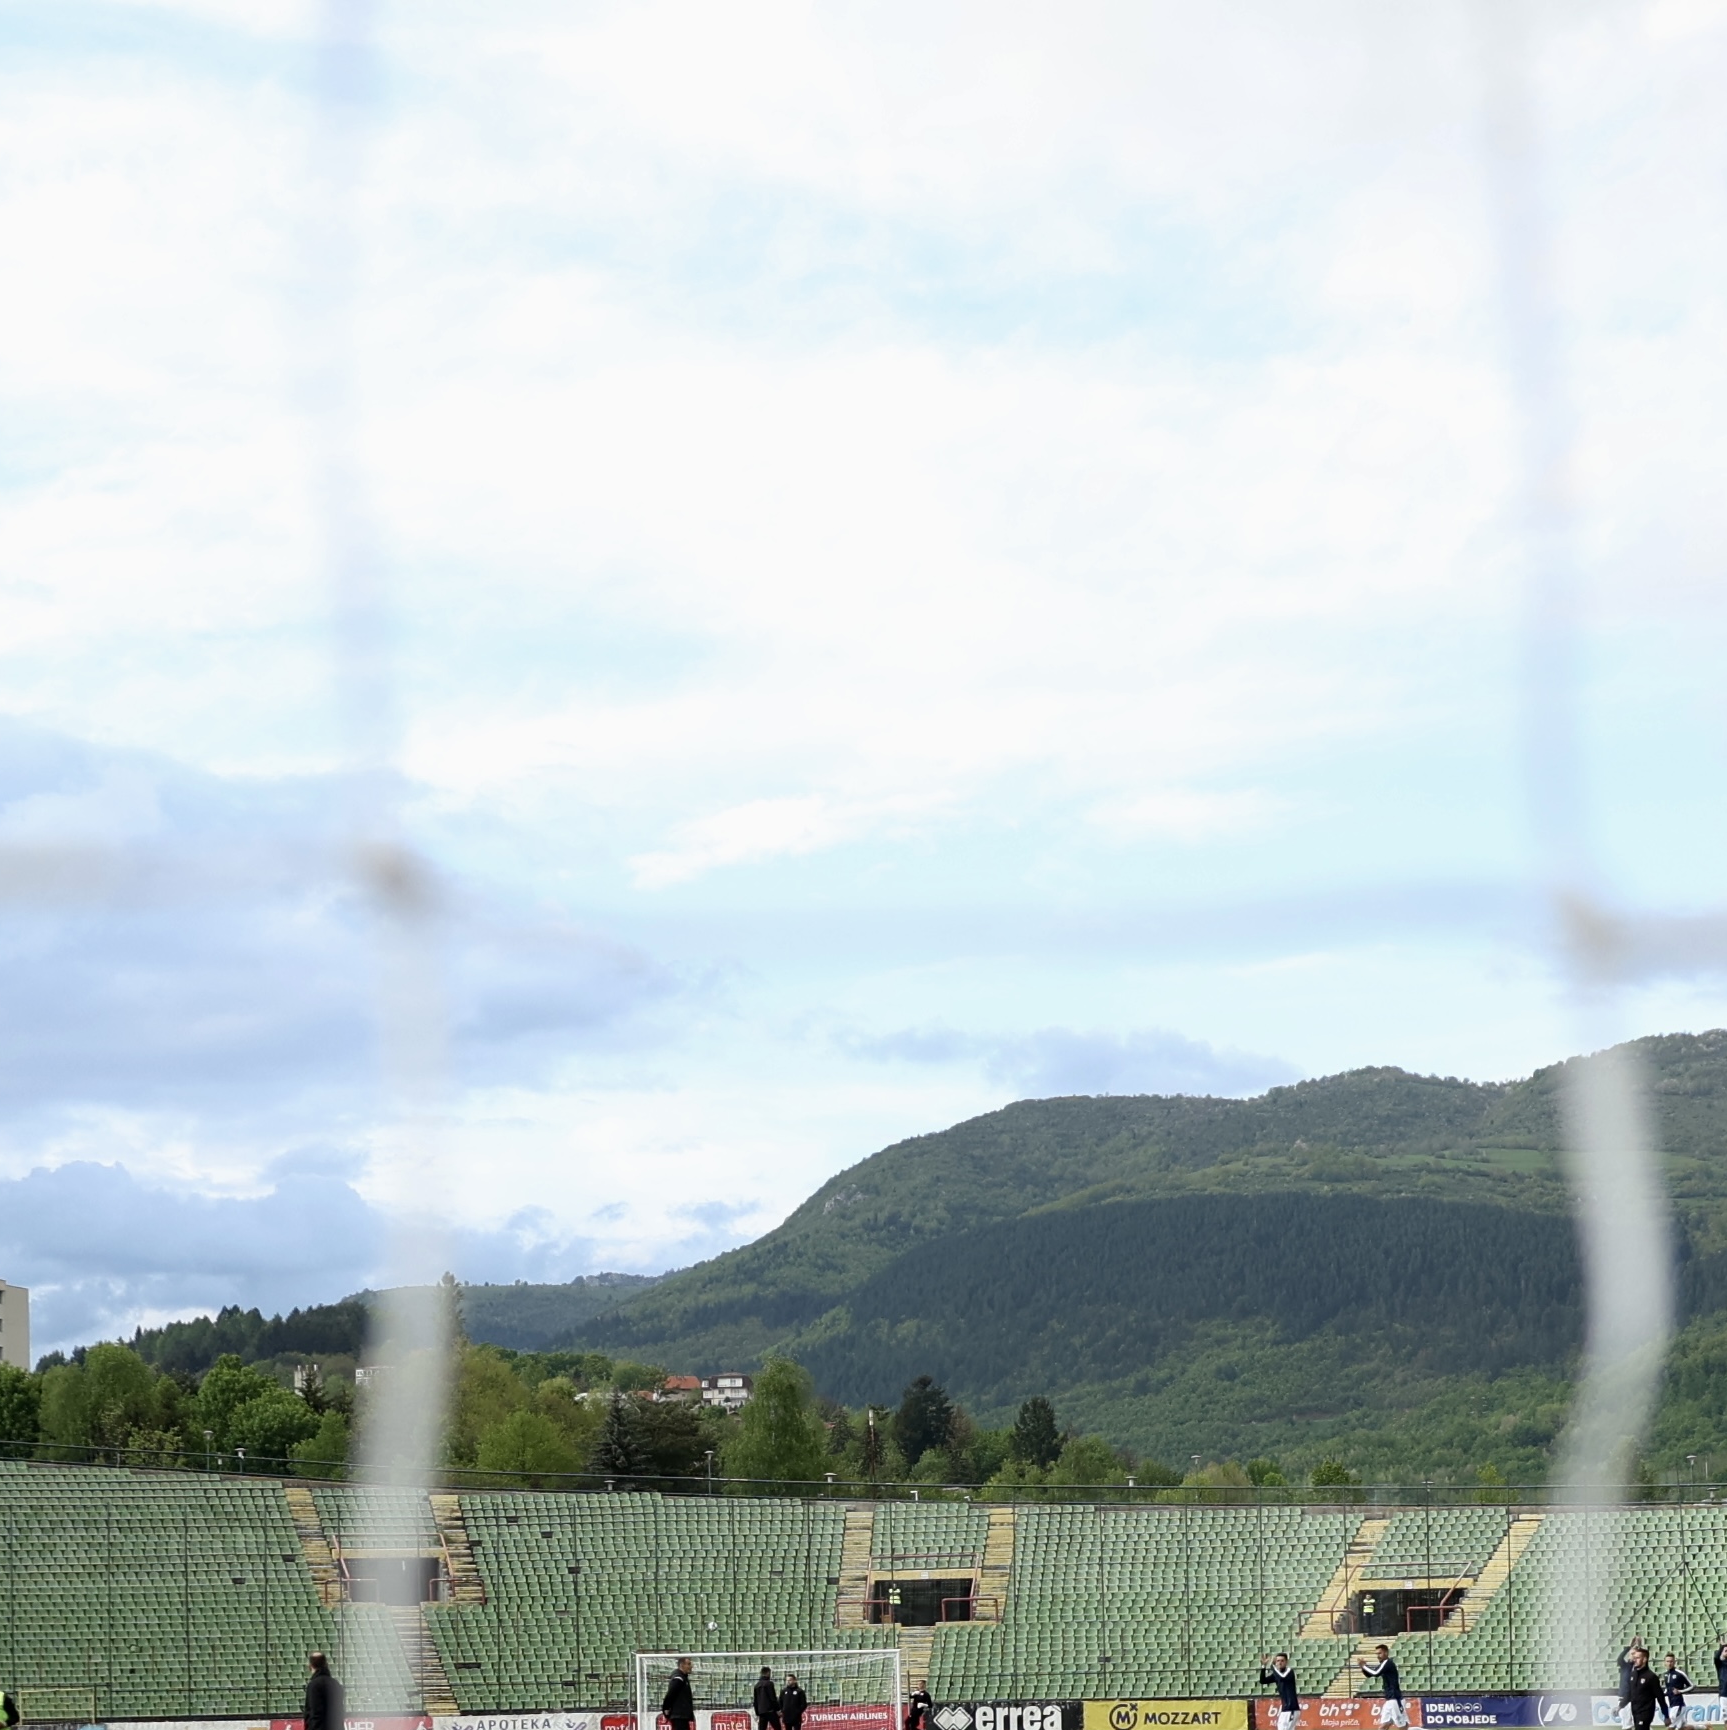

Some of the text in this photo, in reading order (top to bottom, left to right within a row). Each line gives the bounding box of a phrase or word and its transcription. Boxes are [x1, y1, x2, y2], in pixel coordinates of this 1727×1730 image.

[1425, 1703, 1455, 1713] IDEM
[810, 1712, 888, 1721] TURKISH AIRLINES
[1143, 1712, 1222, 1725] MOZZART
[1426, 1715, 1498, 1724] DO POBJEDE
[476, 1718, 552, 1730] APOTEKA
